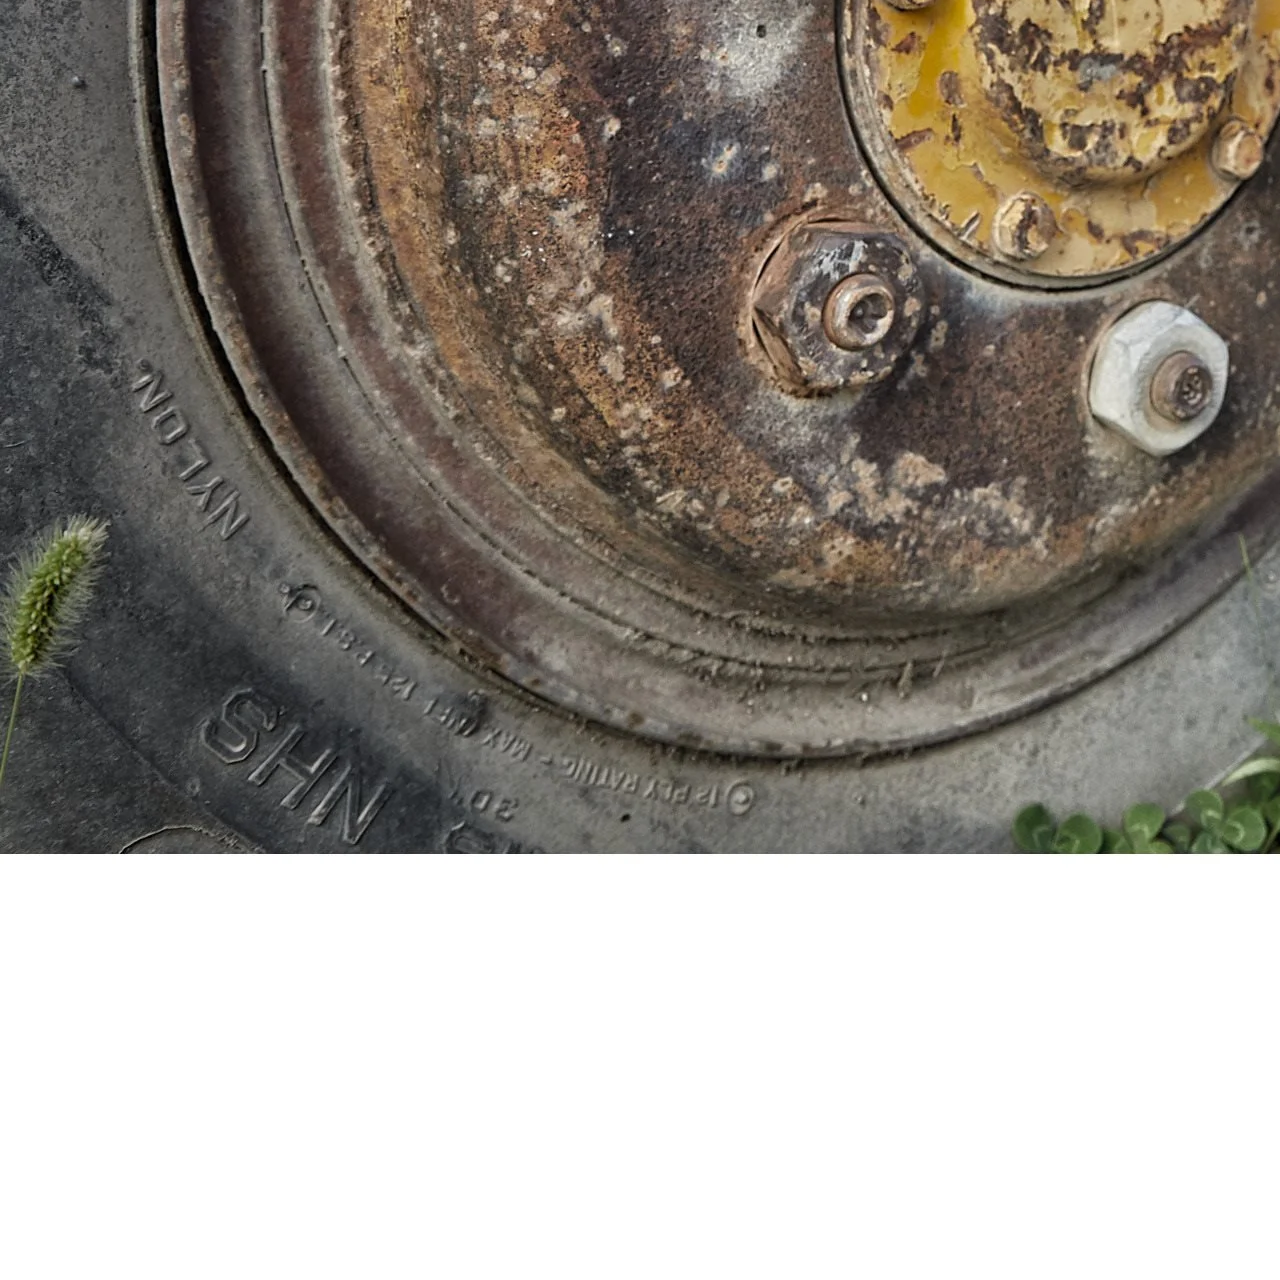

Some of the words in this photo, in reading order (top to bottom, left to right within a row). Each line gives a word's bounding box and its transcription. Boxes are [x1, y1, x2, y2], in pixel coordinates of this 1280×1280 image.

[131, 372, 250, 542] NYLON
[201, 687, 396, 847] NHS
[643, 779, 691, 805] PLY
